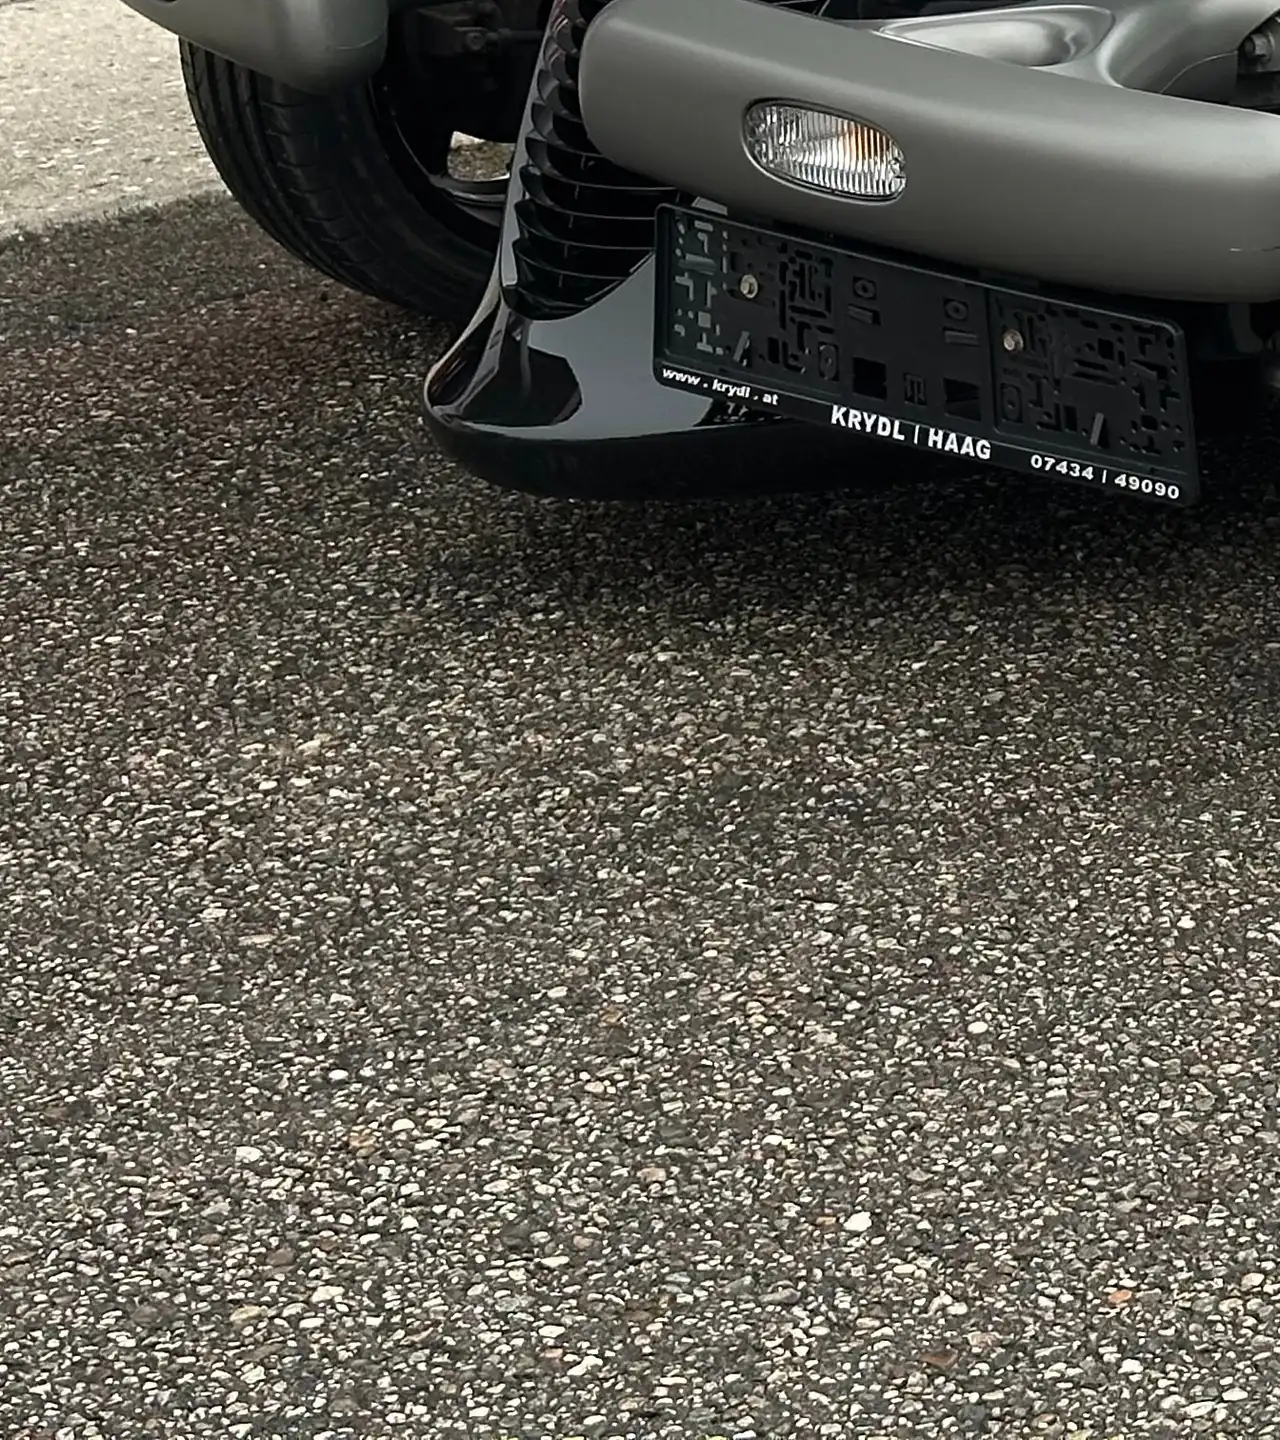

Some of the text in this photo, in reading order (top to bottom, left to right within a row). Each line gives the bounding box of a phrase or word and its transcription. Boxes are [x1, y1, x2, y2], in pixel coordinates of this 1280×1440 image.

[831, 404, 905, 441] KRYDL
[928, 427, 991, 460] HAAG
[1030, 454, 1094, 480] 07434
[1114, 473, 1180, 500] 49090
